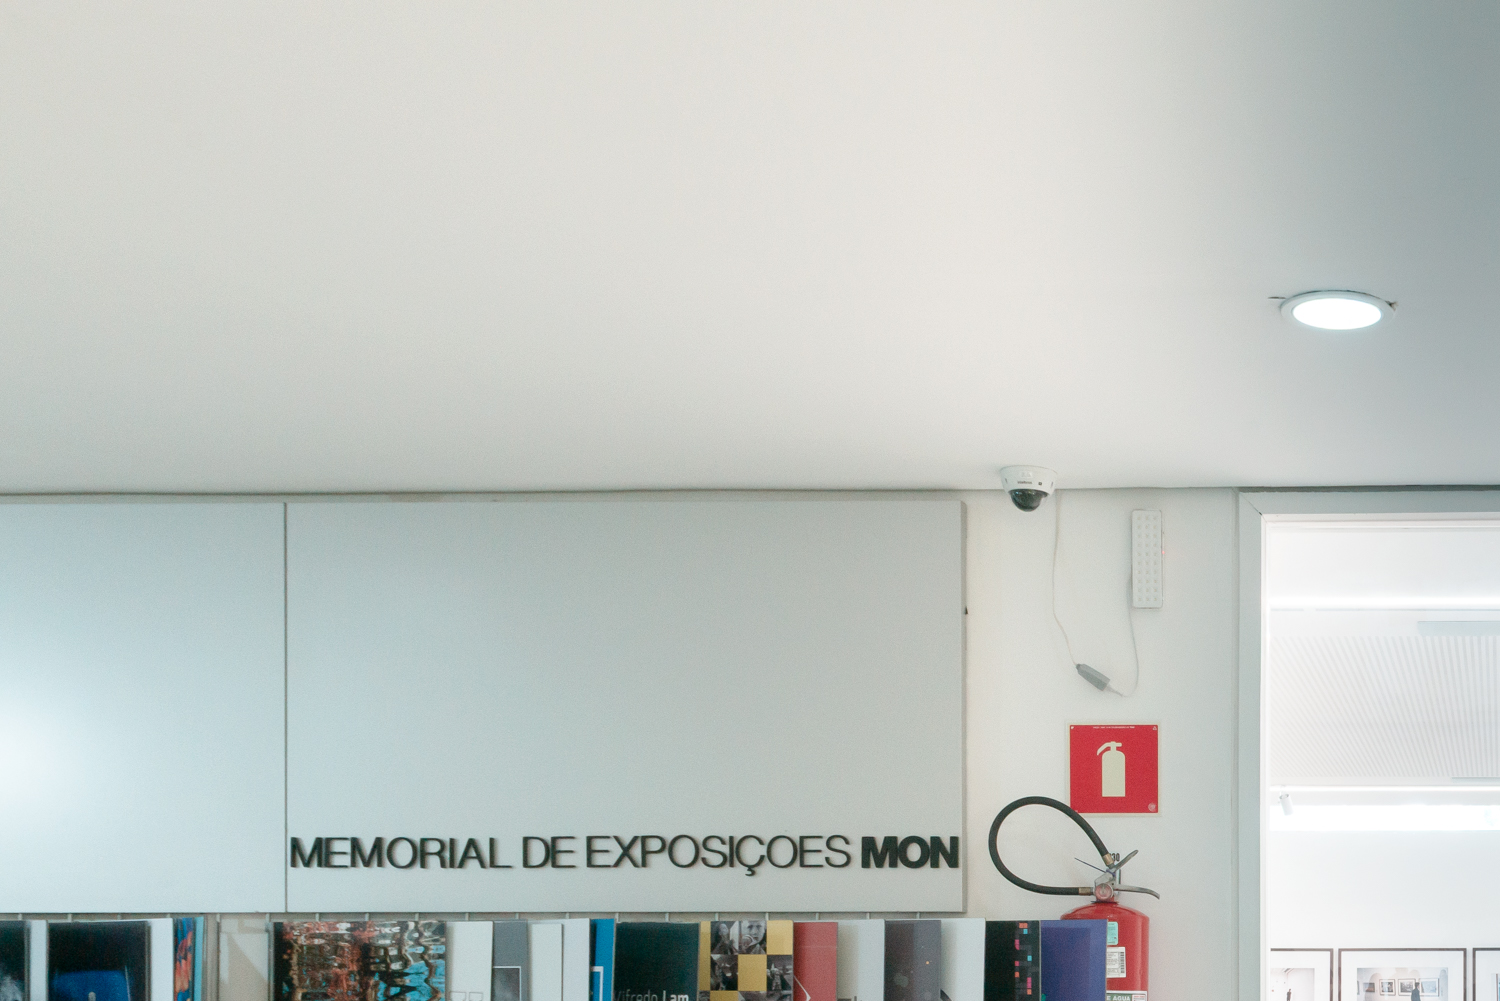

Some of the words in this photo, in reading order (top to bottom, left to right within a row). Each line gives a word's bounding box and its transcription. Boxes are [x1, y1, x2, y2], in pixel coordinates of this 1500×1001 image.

[290, 836, 513, 869] MEMORIAL
[522, 836, 577, 869] DE
[586, 834, 852, 876] EXPOSIÇOES
[861, 835, 960, 869] MON
